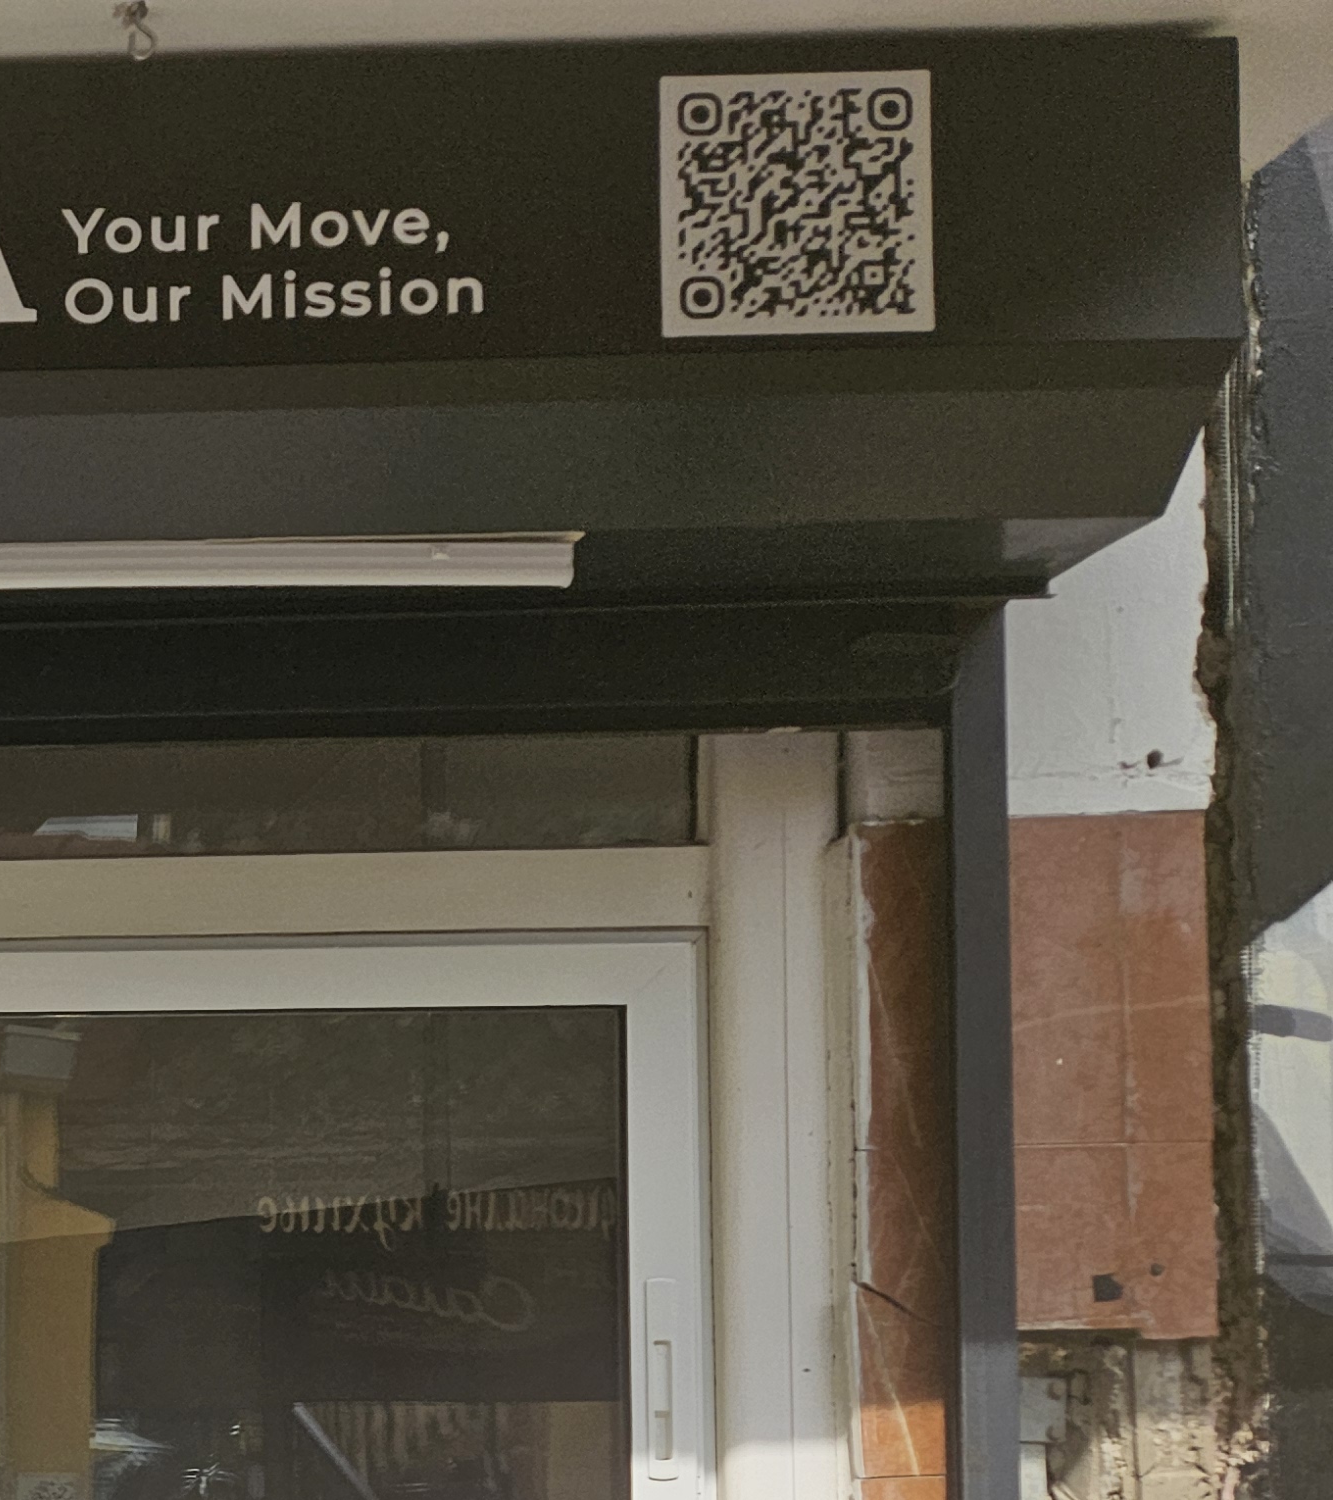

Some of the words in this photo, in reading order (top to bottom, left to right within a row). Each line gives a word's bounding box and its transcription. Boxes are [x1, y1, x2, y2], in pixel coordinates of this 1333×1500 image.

[61, 207, 220, 254] Your
[250, 201, 449, 253] Move,
[64, 277, 191, 324] Our
[222, 266, 484, 321] Mission
